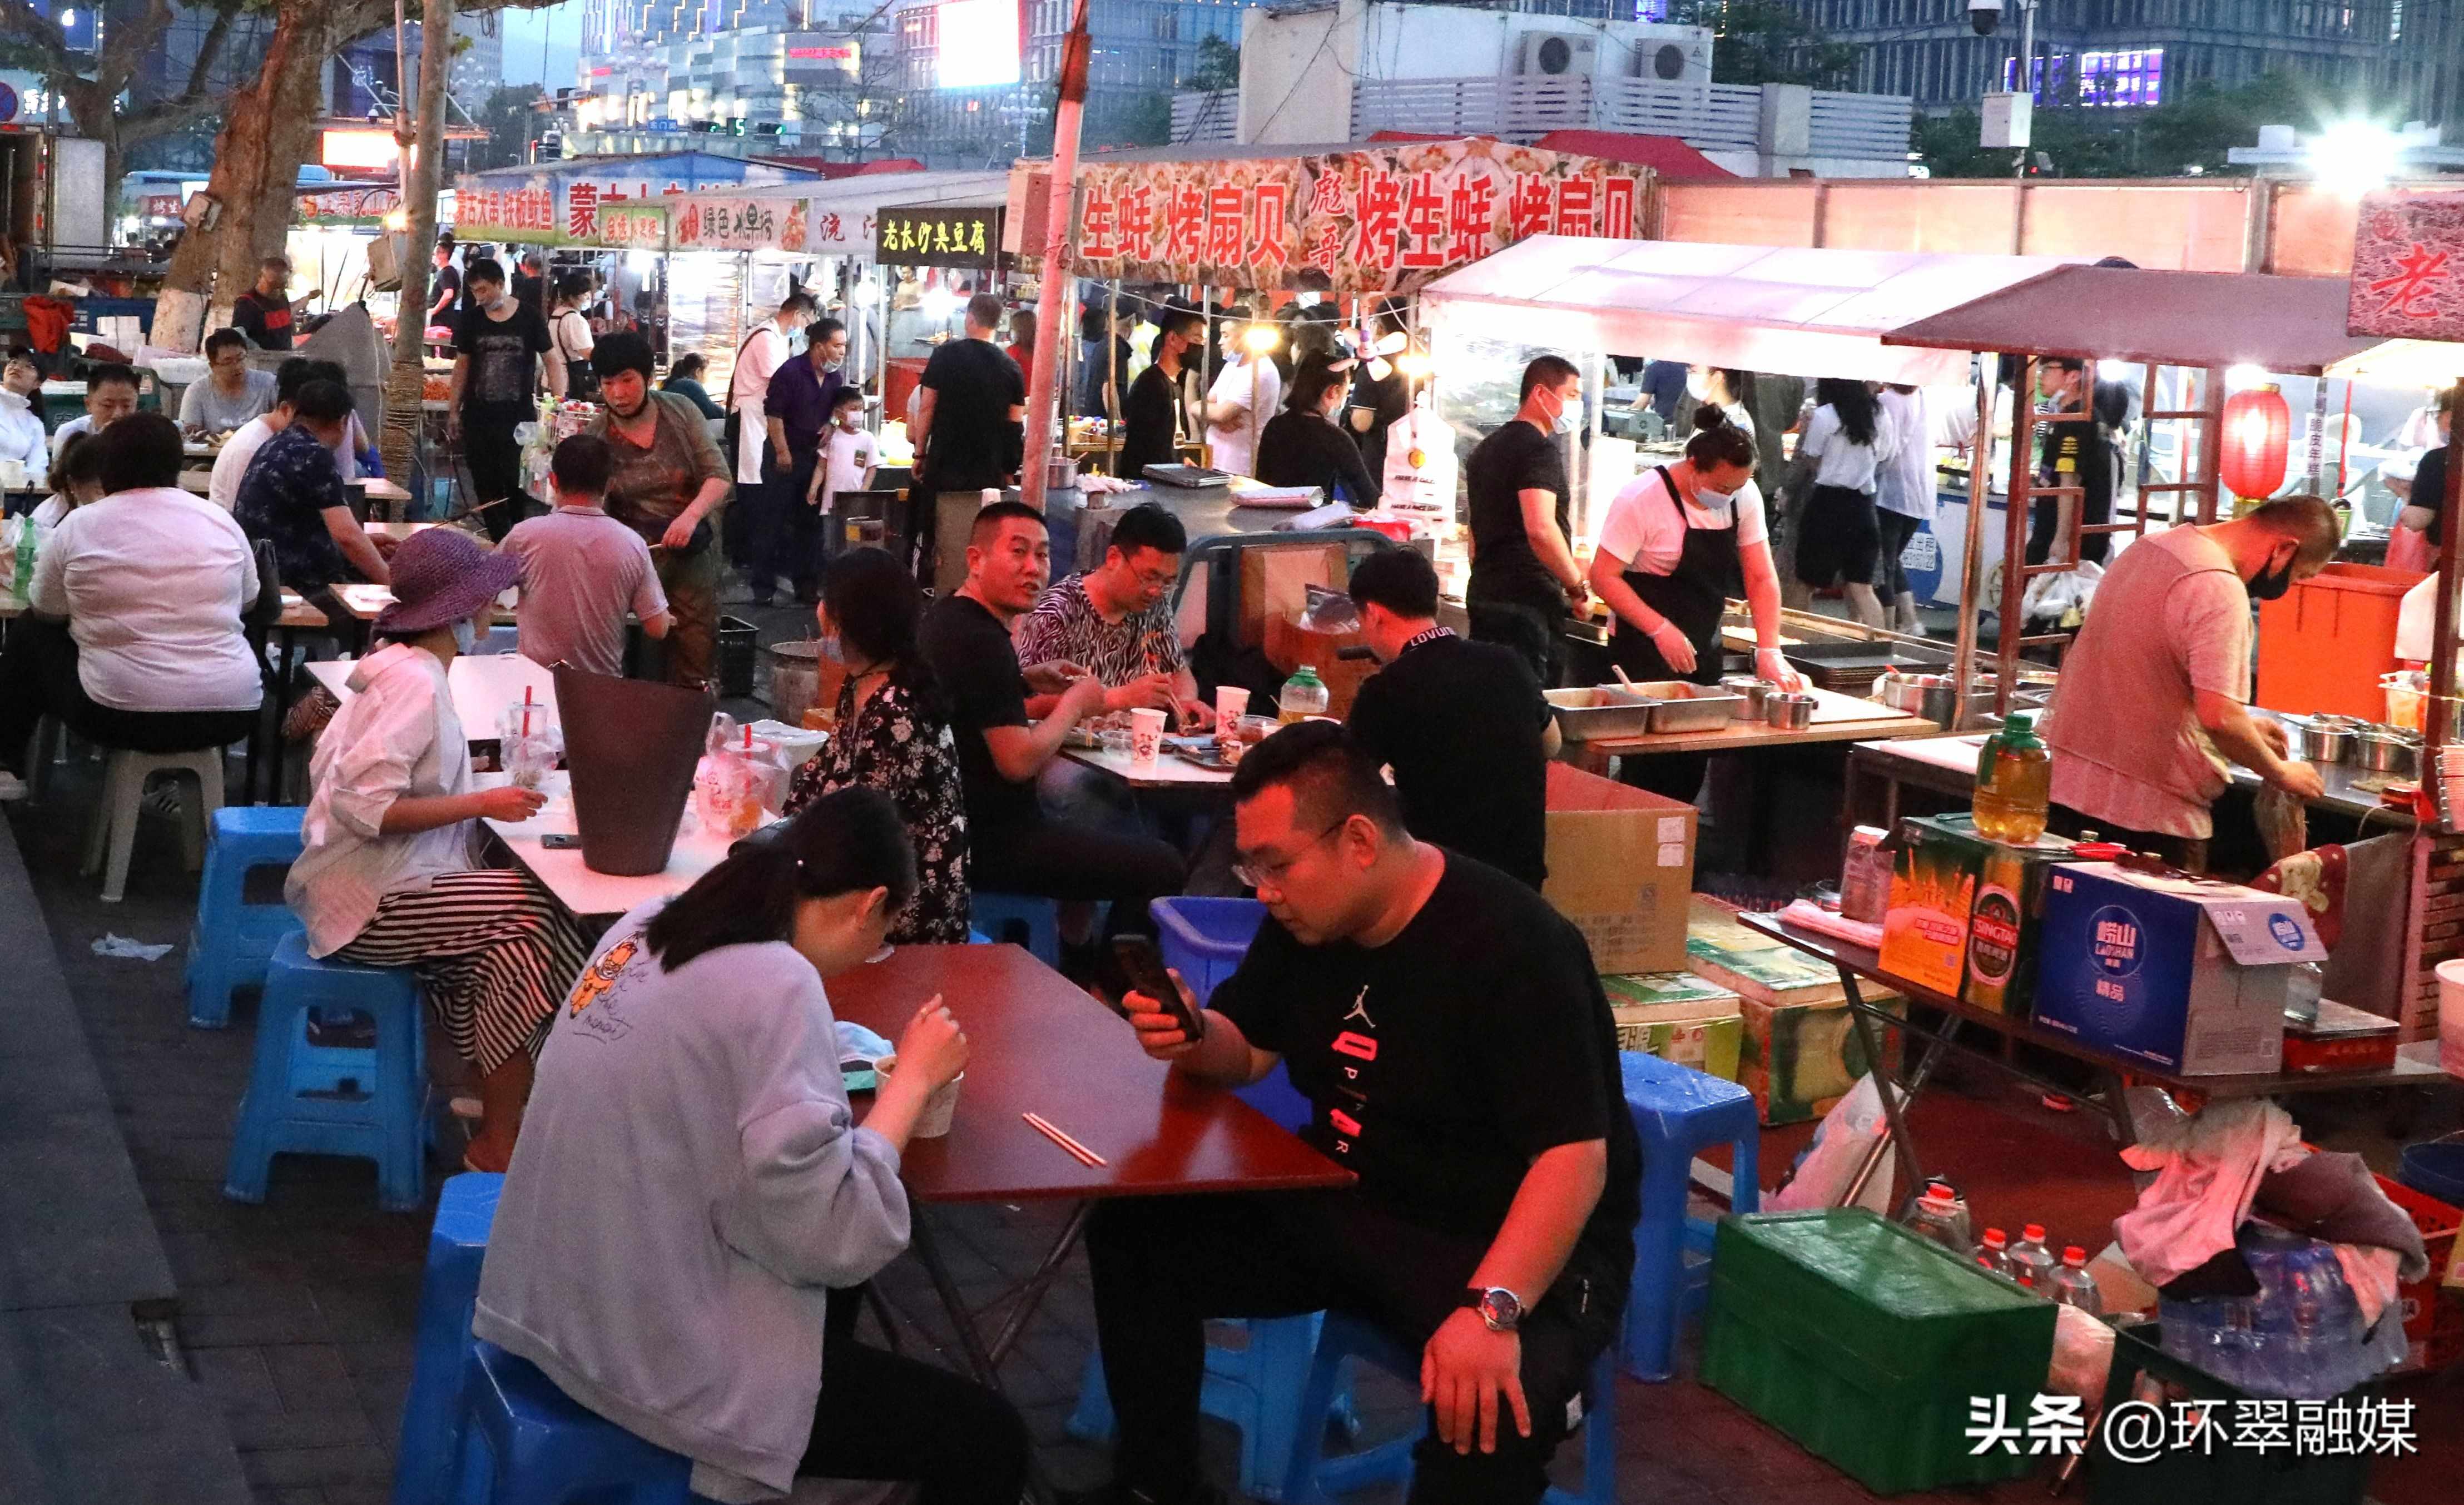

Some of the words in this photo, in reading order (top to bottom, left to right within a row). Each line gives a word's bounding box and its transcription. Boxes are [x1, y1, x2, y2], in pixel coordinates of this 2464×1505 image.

[736, 119, 745, 136] 5
[704, 207, 730, 239] 绿色
[883, 219, 985, 256] 老长沙臭豆腐
[1083, 184, 1152, 261] 生蚝
[1167, 182, 1288, 269] 烤扇贝
[1307, 170, 1346, 276] 彪哥
[1355, 171, 1493, 269] 烤生蚝
[2370, 242, 2451, 317] 老
